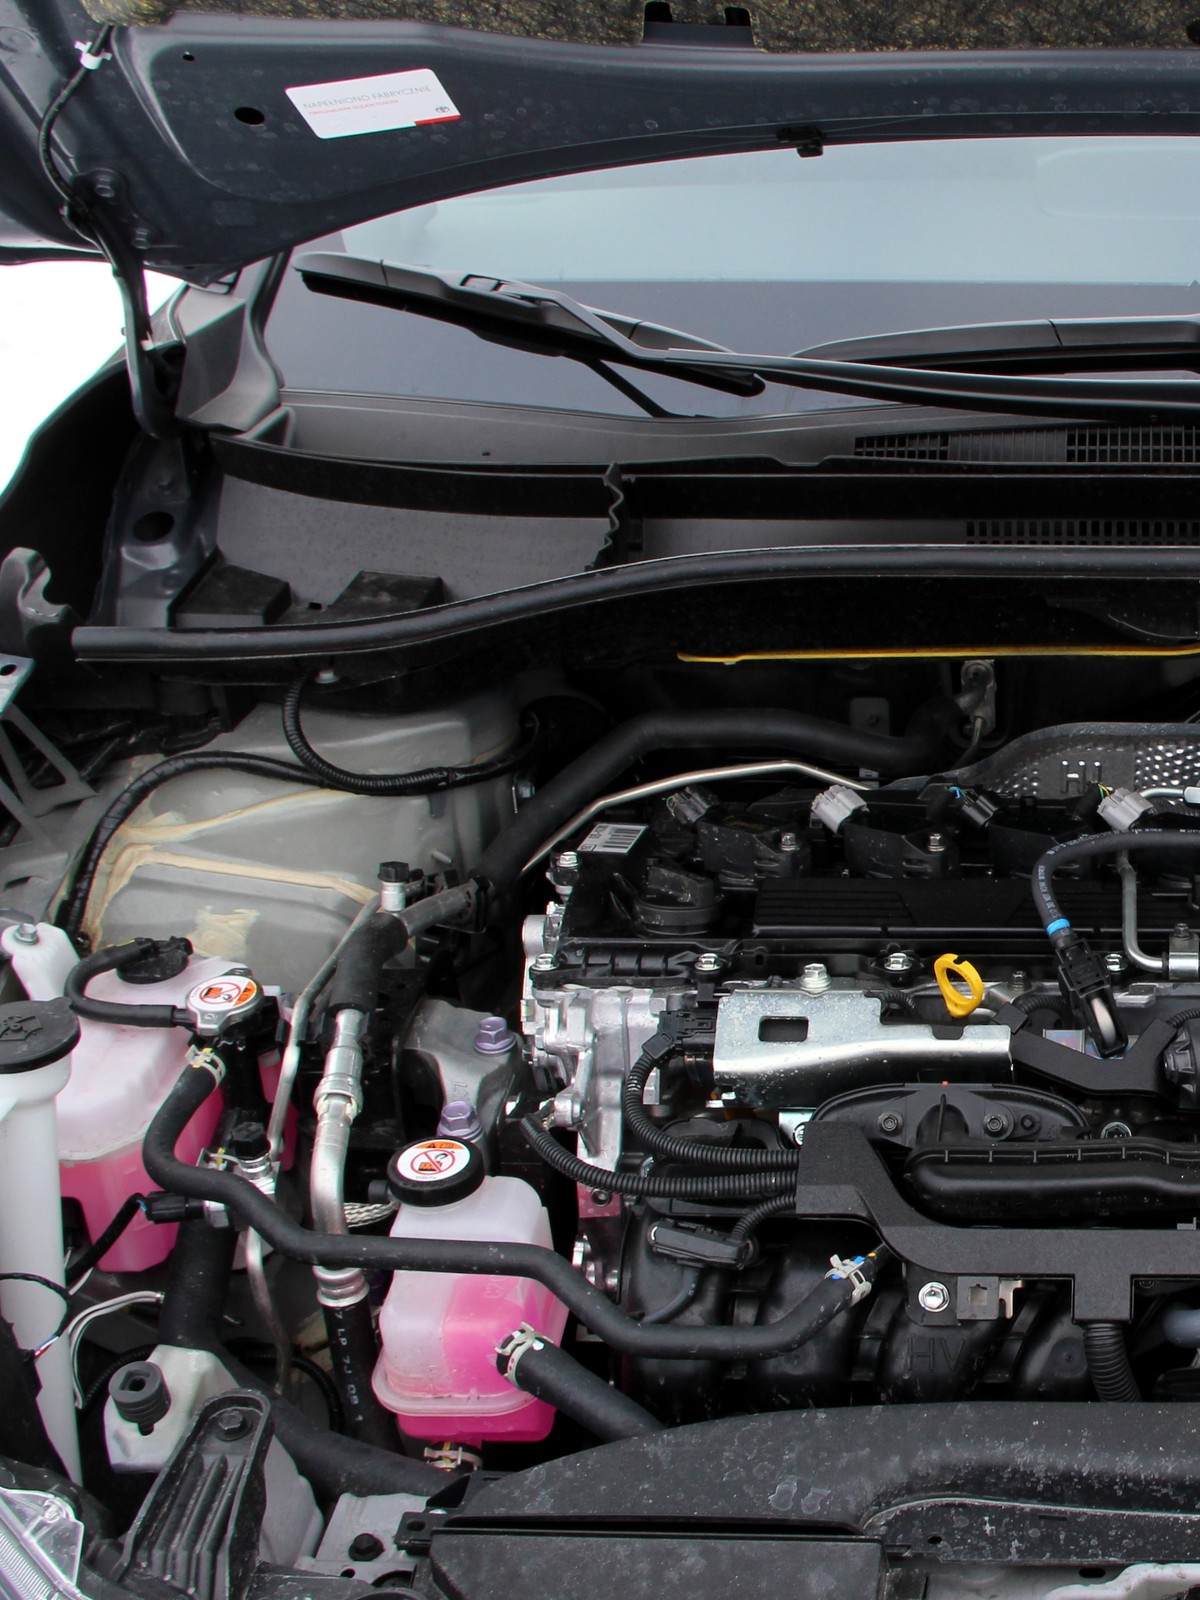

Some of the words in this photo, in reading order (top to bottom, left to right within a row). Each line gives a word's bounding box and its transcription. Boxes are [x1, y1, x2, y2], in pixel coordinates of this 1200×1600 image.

[303, 94, 370, 110] NAPEŁNIONO
[372, 85, 433, 100] FABRYCZNIE
[906, 1337, 966, 1372] HV
